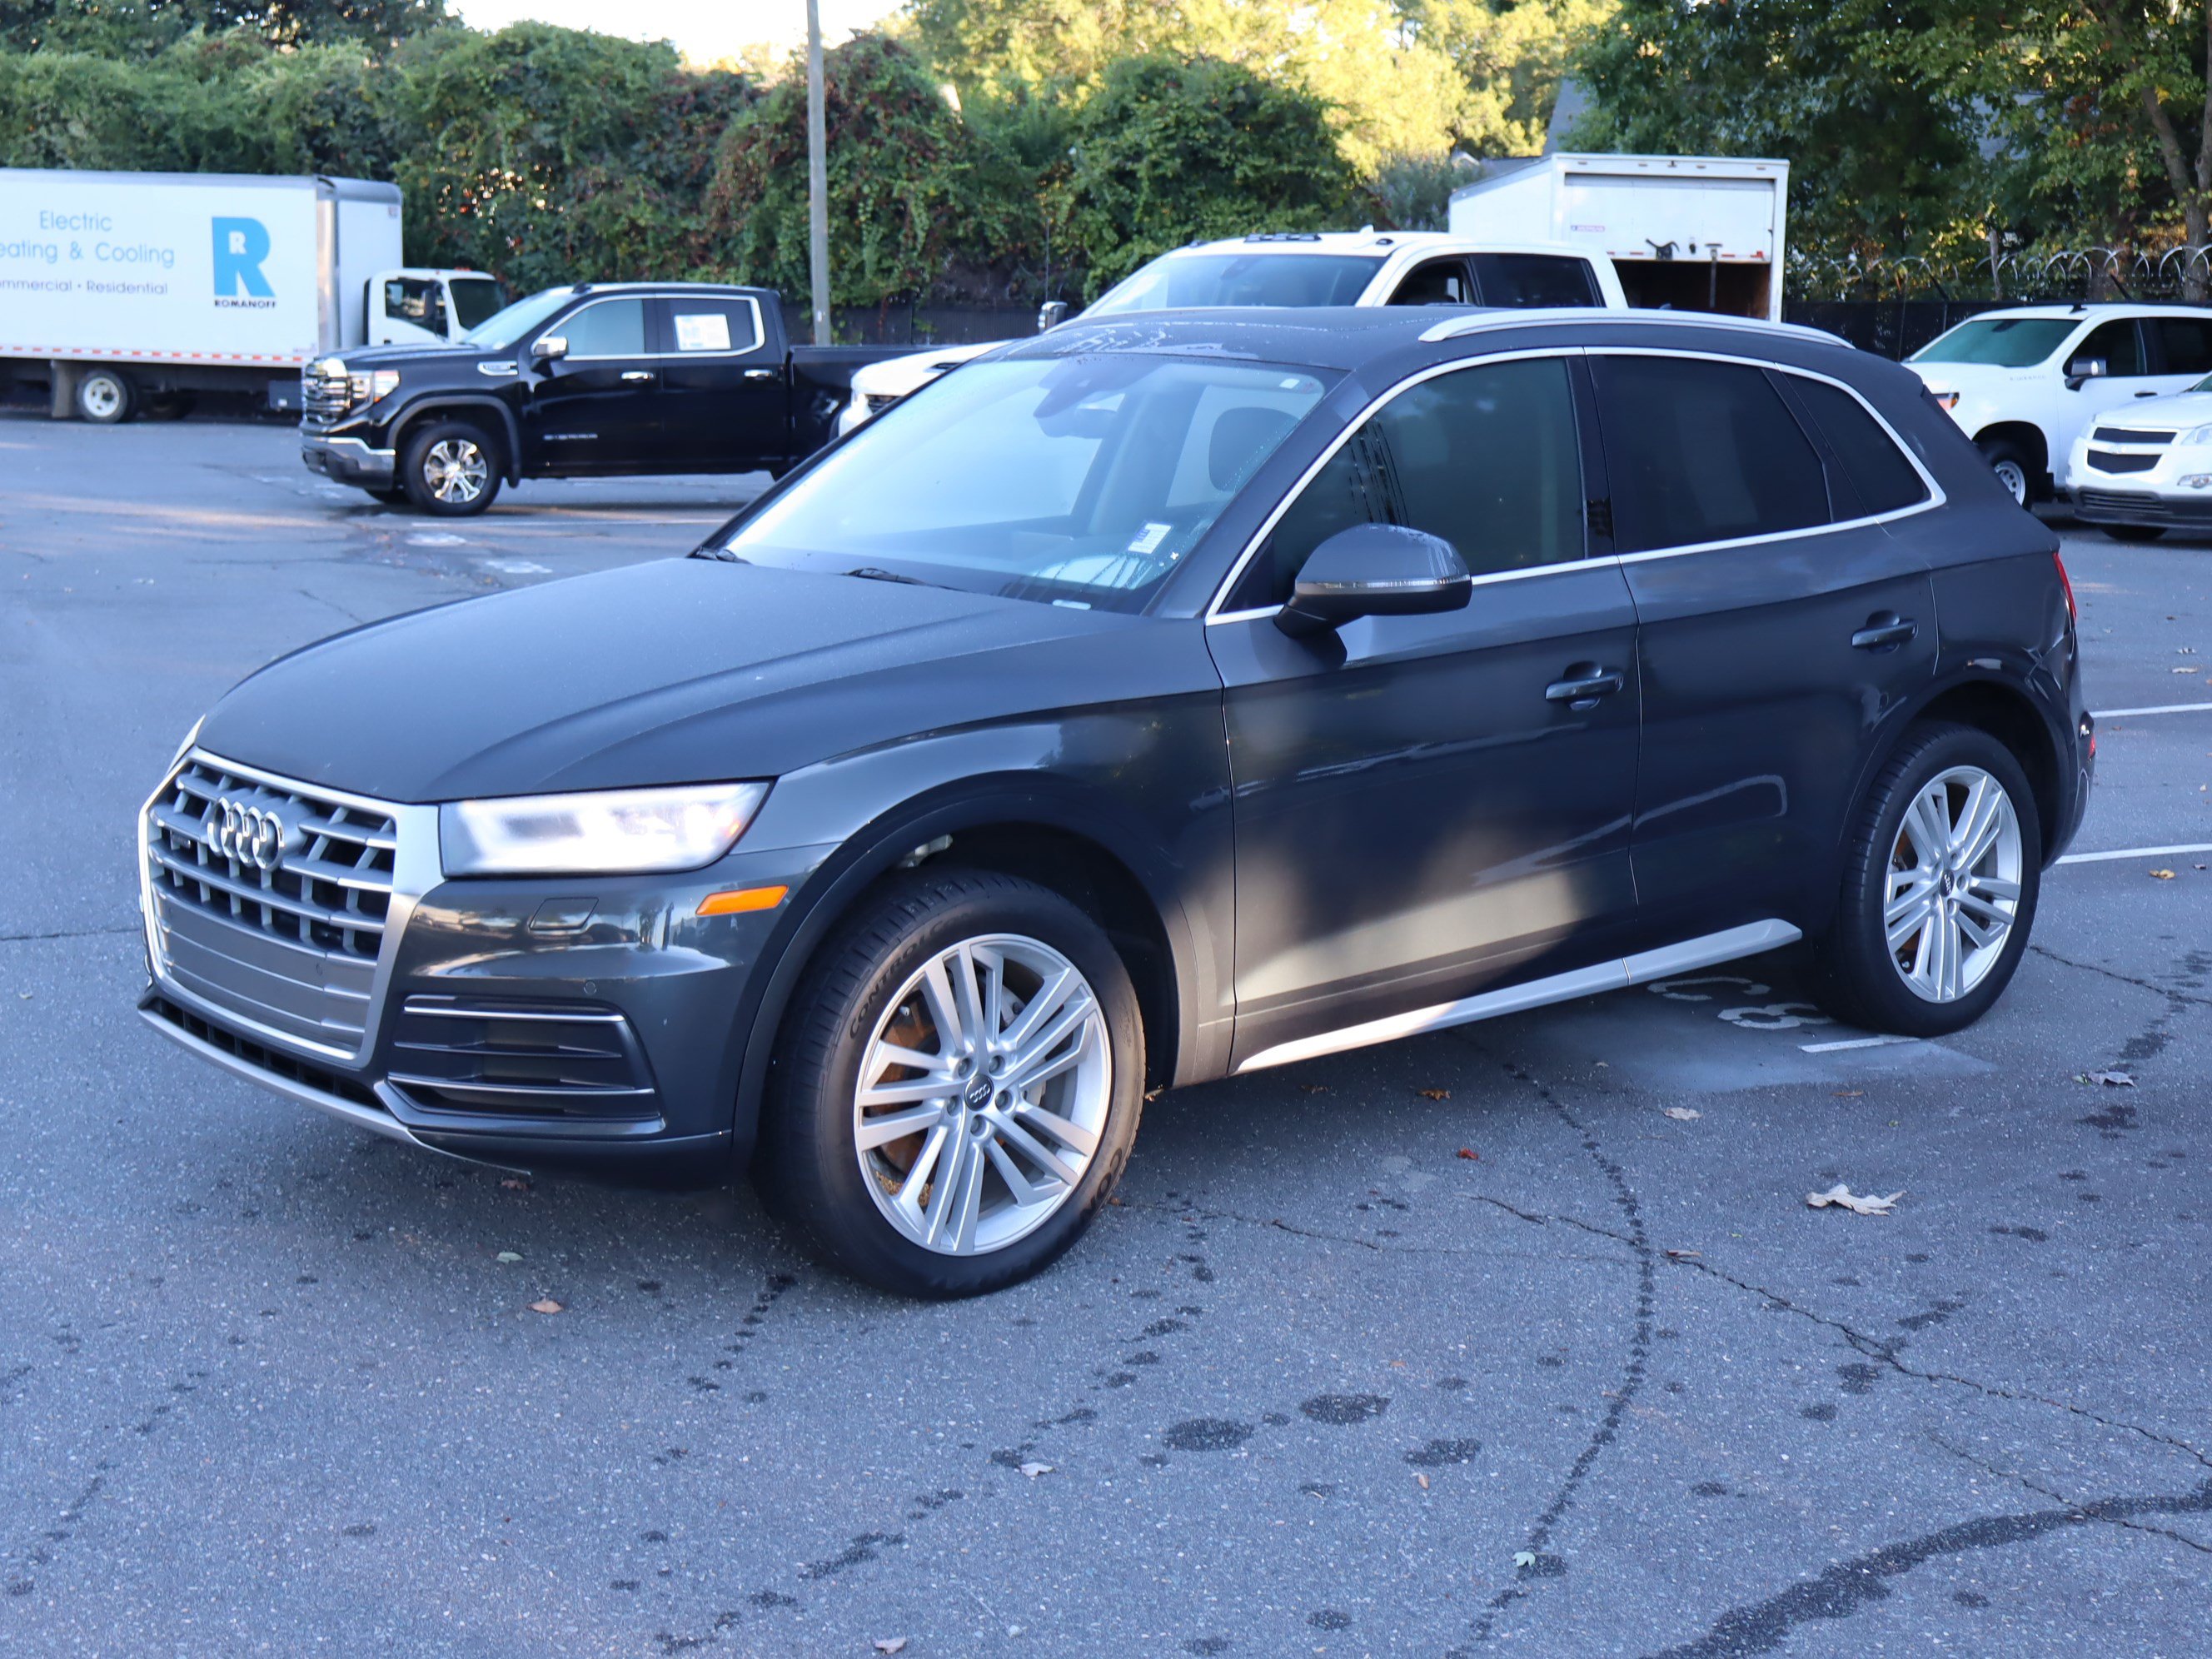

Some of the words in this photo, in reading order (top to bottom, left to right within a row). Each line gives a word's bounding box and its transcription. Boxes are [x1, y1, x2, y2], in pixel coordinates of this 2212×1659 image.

[40, 210, 112, 232] Electric
[229, 232, 247, 255] R
[69, 241, 83, 260] &
[95, 242, 175, 269] Cooling
[212, 217, 276, 297] R
[87, 280, 168, 295] Residential
[214, 300, 276, 308] ROMANOFF
